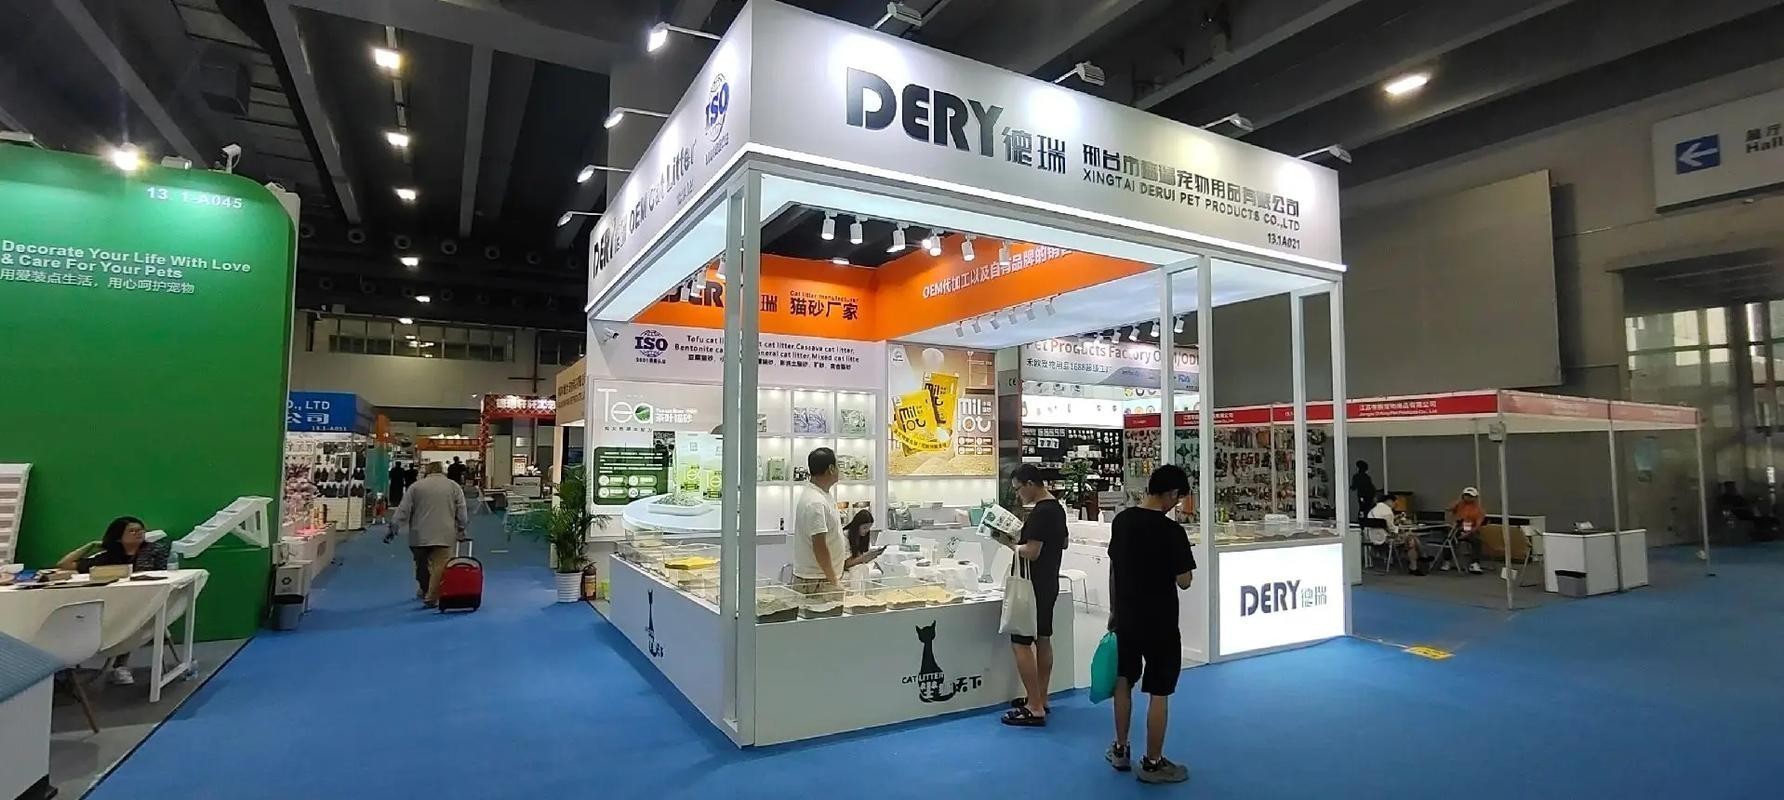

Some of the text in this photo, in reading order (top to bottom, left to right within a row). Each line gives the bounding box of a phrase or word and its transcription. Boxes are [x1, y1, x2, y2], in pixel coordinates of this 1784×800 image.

[705, 82, 729, 128] ISO
[846, 67, 1003, 158] DERY
[1002, 126, 1067, 175] 德瑞
[1746, 136, 1784, 153] Hall
[1082, 143, 1300, 219] 邢台市德瑞宠物用品有限公司
[1083, 168, 1136, 192] XINGTAI
[1140, 182, 1176, 202] DERUI
[1180, 192, 1201, 207] PET
[1205, 198, 1260, 221] PRODUCTS
[1267, 232, 1301, 249] 13.1A021
[1, 253, 183, 279] & Care For Your Pets
[2, 239, 251, 273] Decorate Your Life With Love
[790, 297, 859, 321] 猫砂厂家
[635, 336, 669, 351] ISO
[674, 343, 714, 353] Bentonite
[687, 335, 704, 344] Tofu
[764, 341, 776, 349] cat
[305, 400, 330, 411] LTD
[597, 388, 654, 424] Tea
[1240, 579, 1301, 617] DERY
[902, 675, 917, 684] CAT
